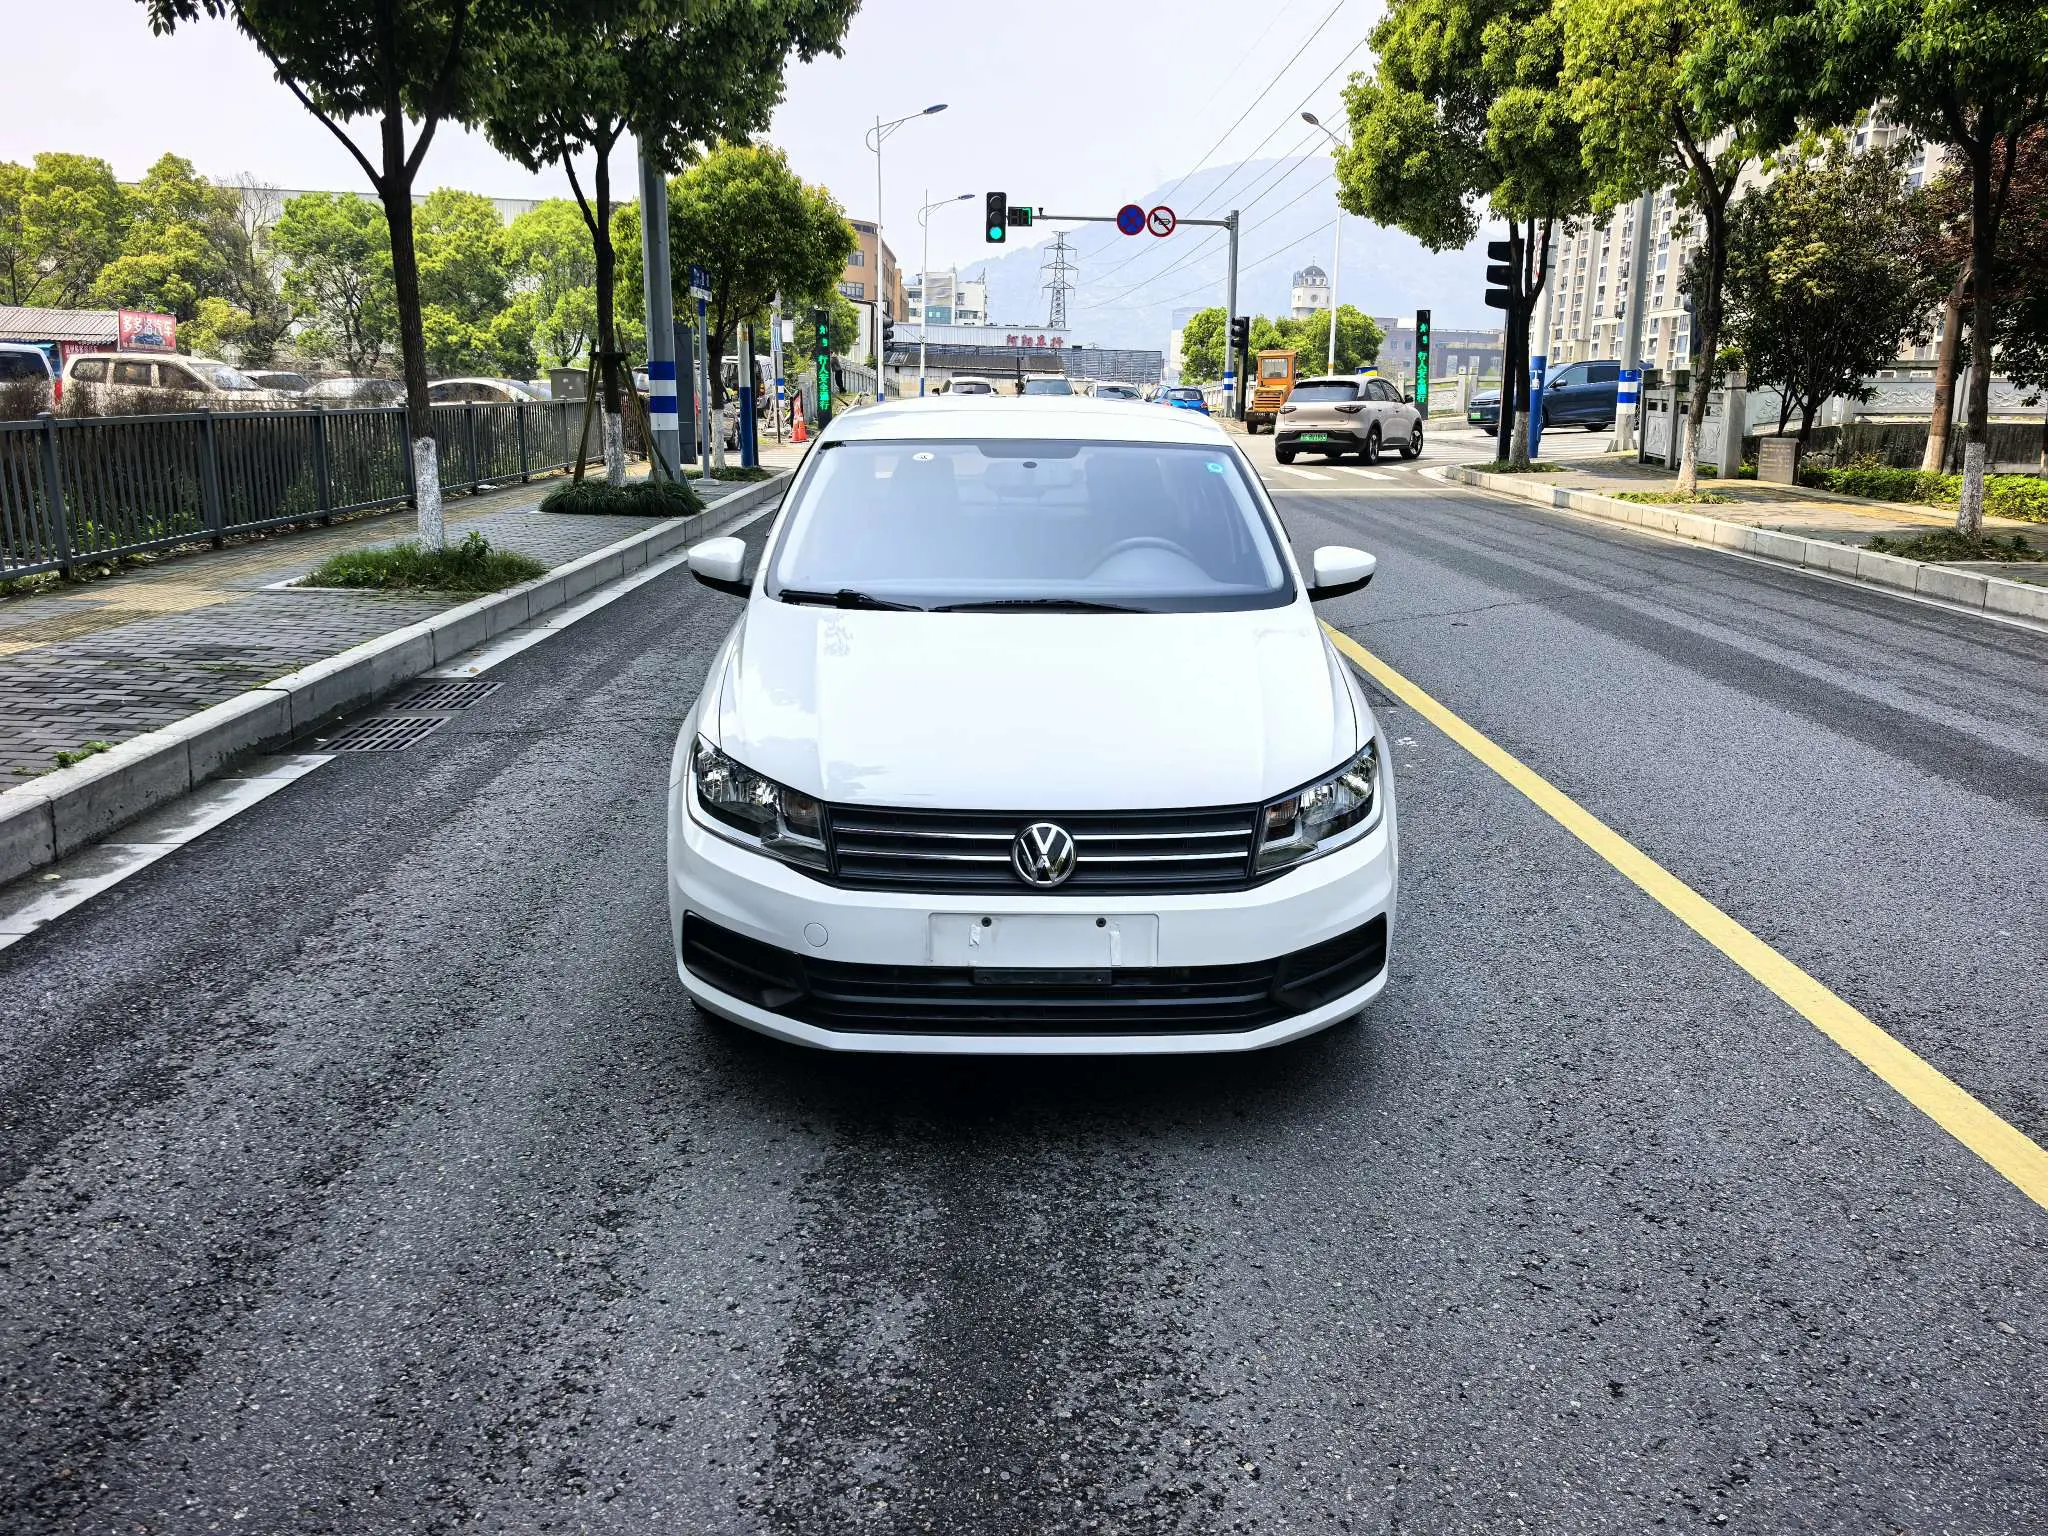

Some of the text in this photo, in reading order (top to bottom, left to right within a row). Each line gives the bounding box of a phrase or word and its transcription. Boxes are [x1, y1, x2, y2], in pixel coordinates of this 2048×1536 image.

[818, 355, 830, 411] 行人安全通行
